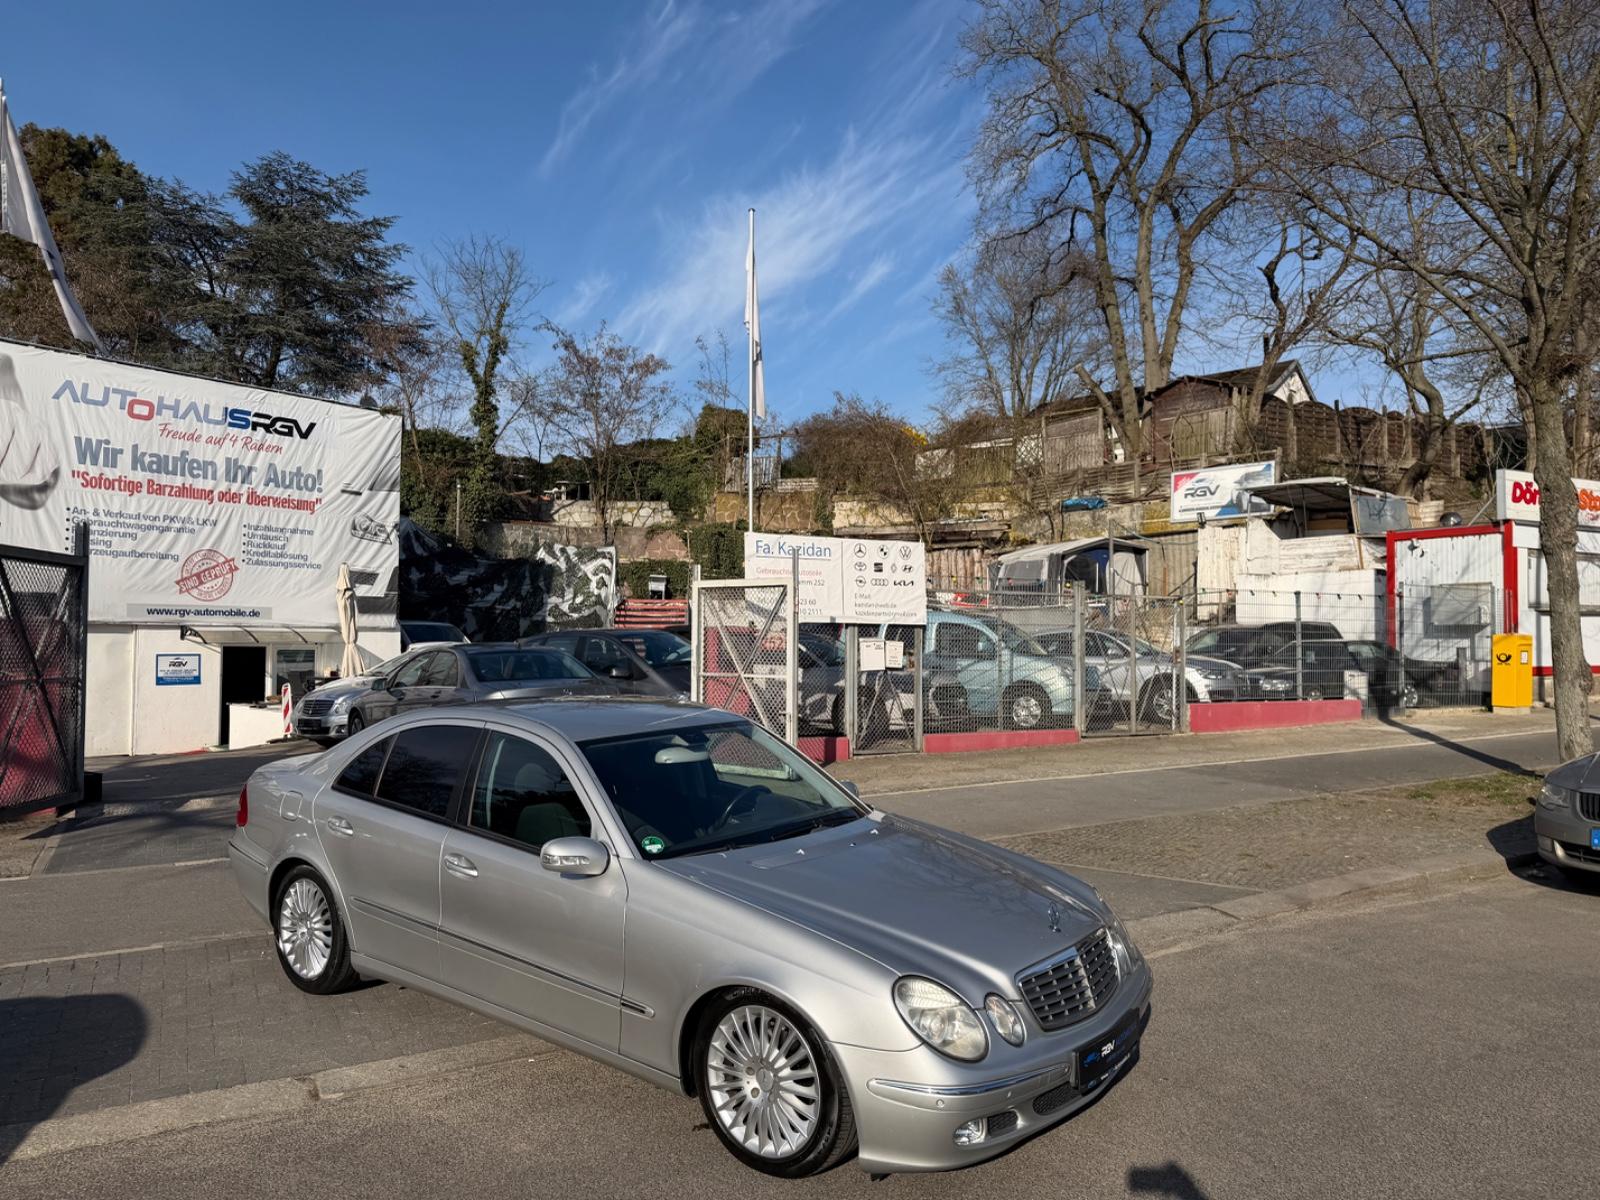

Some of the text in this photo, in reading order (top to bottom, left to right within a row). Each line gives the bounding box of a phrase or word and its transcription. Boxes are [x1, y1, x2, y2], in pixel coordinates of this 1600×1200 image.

[158, 422, 200, 443] Freude
[205, 432, 229, 449] auf
[229, 432, 238, 446] 4
[74, 435, 323, 493] Wir kaufen Ihr Auto!
[71, 469, 323, 515] "Sofortige Barzahlung oder Überweisung"
[1184, 484, 1221, 499] RGV
[72, 506, 90, 515] An-
[92, 508, 101, 517] &
[103, 508, 141, 521] Verkauf
[142, 514, 161, 523] von
[163, 514, 185, 525] PKW
[197, 519, 218, 528] LKW
[247, 532, 289, 543] Umtausch
[755, 539, 774, 555] Fa.
[245, 549, 309, 562] Kreditablösung
[245, 557, 322, 570] Zulassungsservice
[179, 575, 199, 592] SIND
[146, 607, 261, 618] www.rgv-automobile.de
[168, 660, 188, 668] RGV
[1101, 1039, 1116, 1058] RGV
